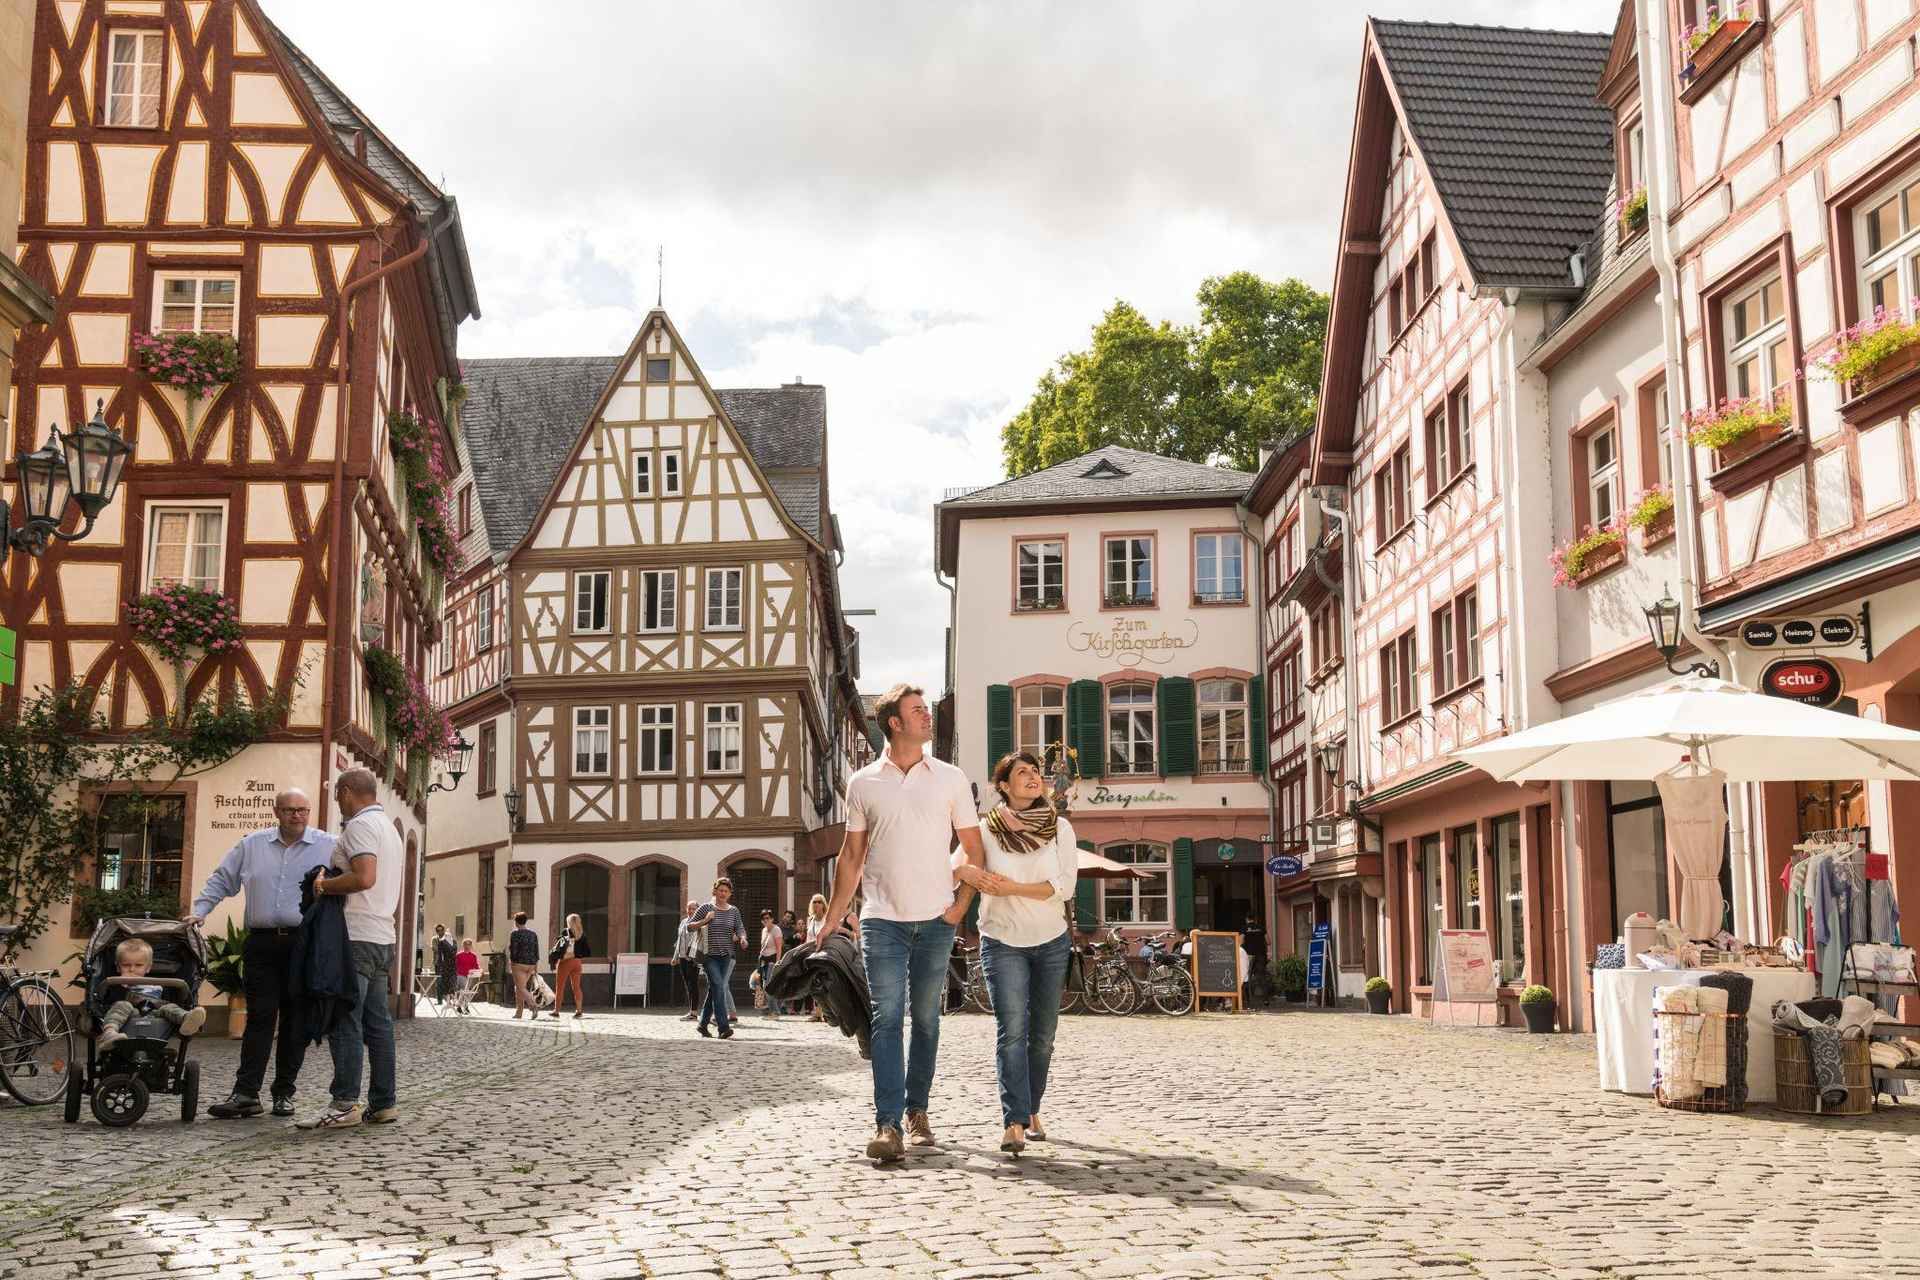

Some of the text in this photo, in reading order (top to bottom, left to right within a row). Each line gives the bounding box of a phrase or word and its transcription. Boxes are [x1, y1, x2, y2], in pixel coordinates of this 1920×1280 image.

[1111, 617, 1147, 631] Zum
[1748, 626, 1851, 639] Sanitär Heizung Elektrik
[245, 780, 275, 792] Zum
[214, 794, 274, 808] Aschaffen
[1087, 787, 1178, 808] Bergschön
